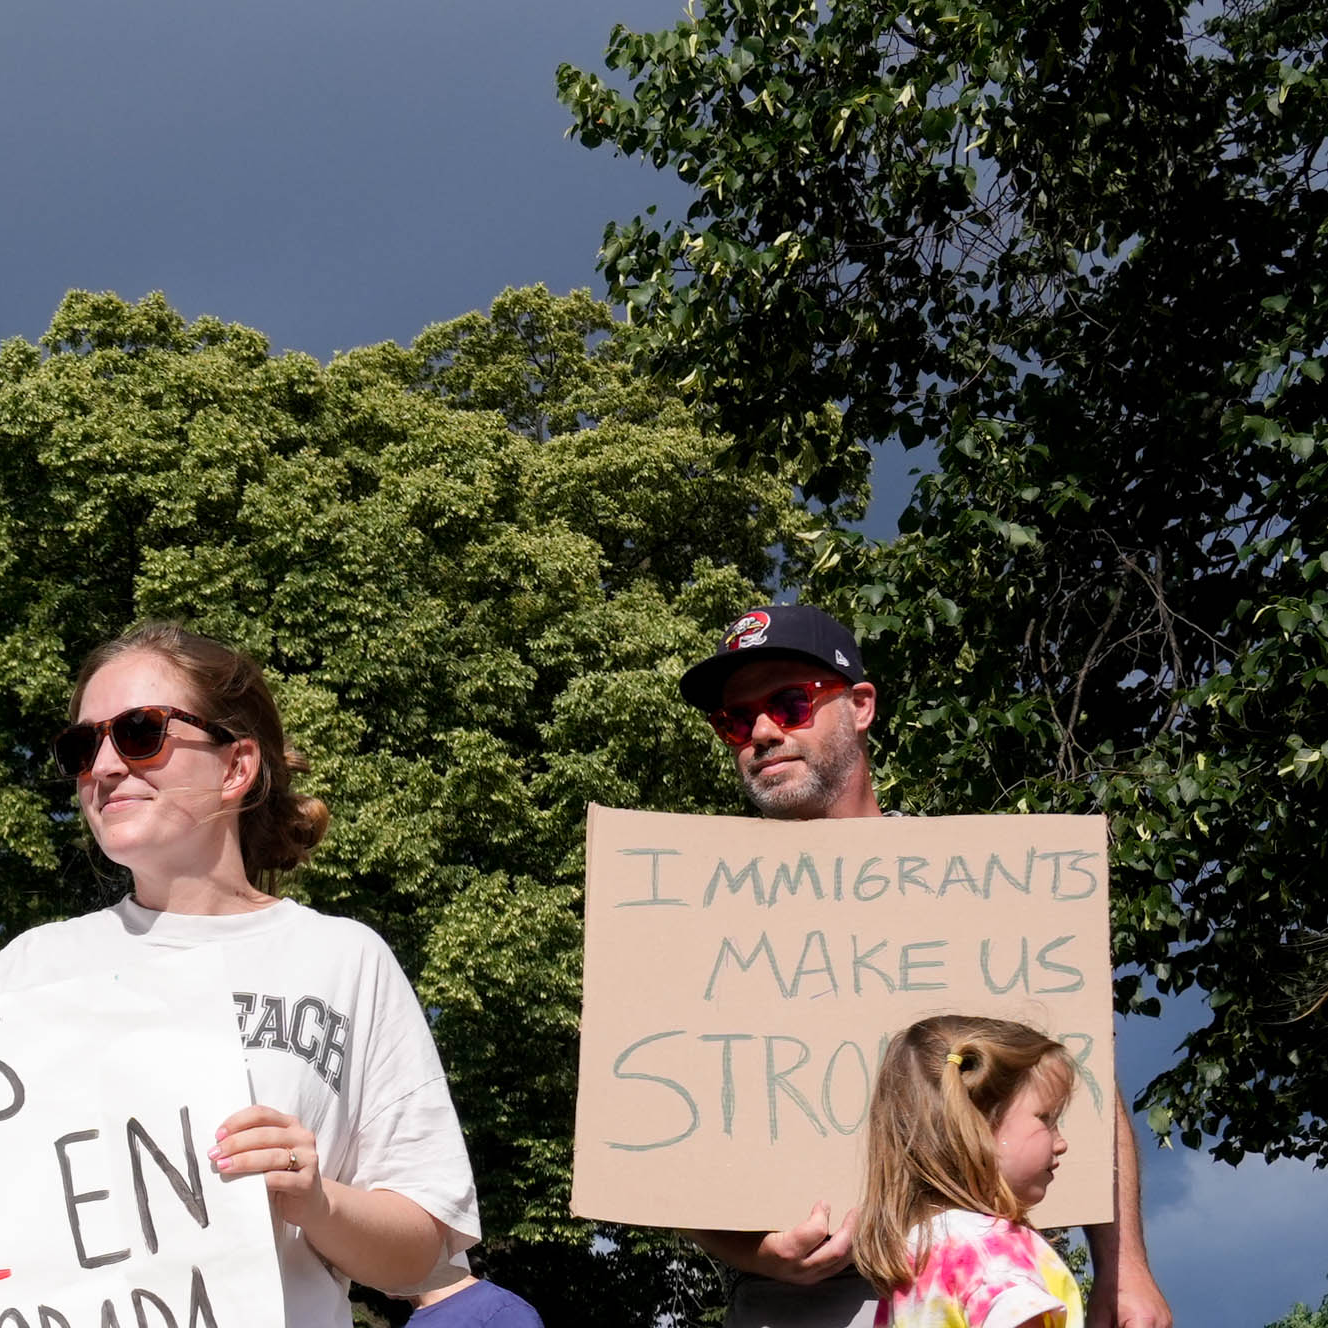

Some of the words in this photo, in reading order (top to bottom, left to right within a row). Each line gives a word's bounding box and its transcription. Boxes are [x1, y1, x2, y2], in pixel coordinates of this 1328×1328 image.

[616, 846, 1097, 908] IMMIGRANTS
[704, 931, 948, 1001] MAKE
[981, 935, 1084, 994] US
[607, 1031, 1101, 1152] STROR
[54, 1106, 213, 1269] EN
